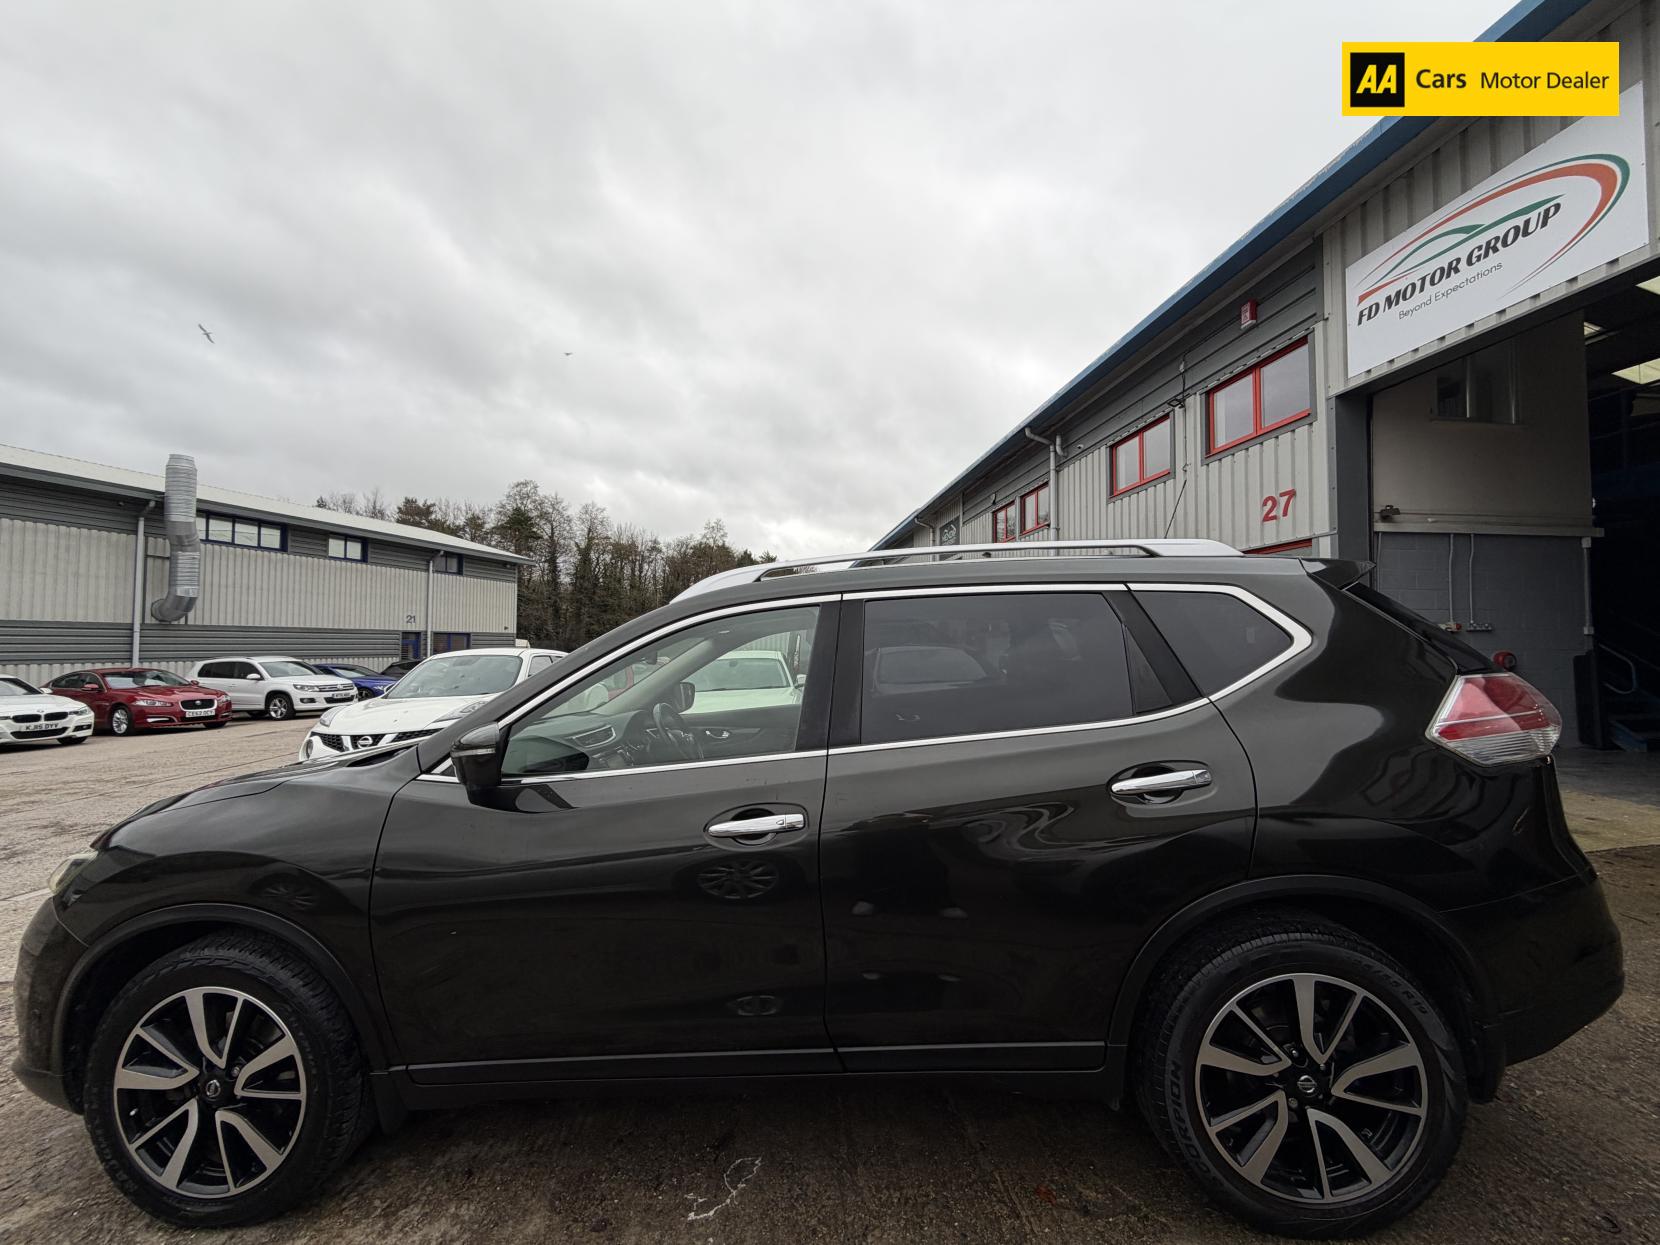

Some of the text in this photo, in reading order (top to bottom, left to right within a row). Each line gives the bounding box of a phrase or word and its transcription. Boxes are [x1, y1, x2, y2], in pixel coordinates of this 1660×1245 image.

[1357, 202, 1562, 327] FD MOTOR GROUP
[1398, 262, 1503, 320] Beyond Expectations
[1262, 488, 1297, 523] 27
[405, 614, 416, 624] 21
